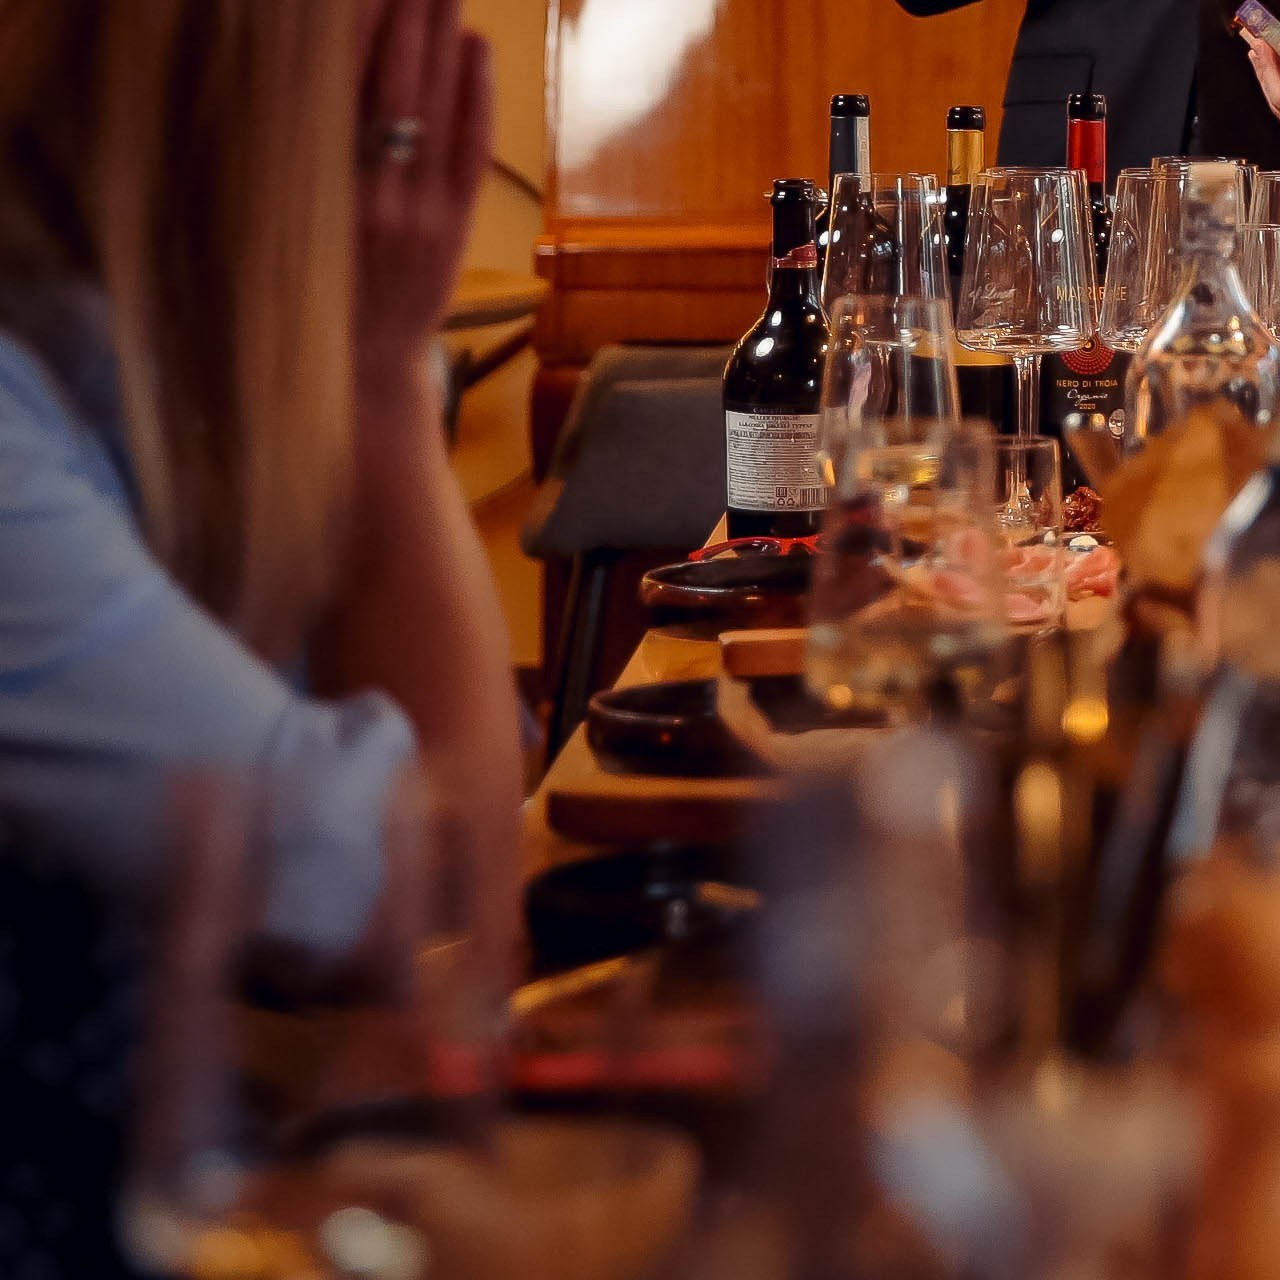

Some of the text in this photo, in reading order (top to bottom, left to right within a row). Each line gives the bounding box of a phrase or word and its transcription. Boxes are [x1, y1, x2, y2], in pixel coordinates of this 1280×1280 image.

[1056, 379, 1119, 388] NERO DI TROIA
